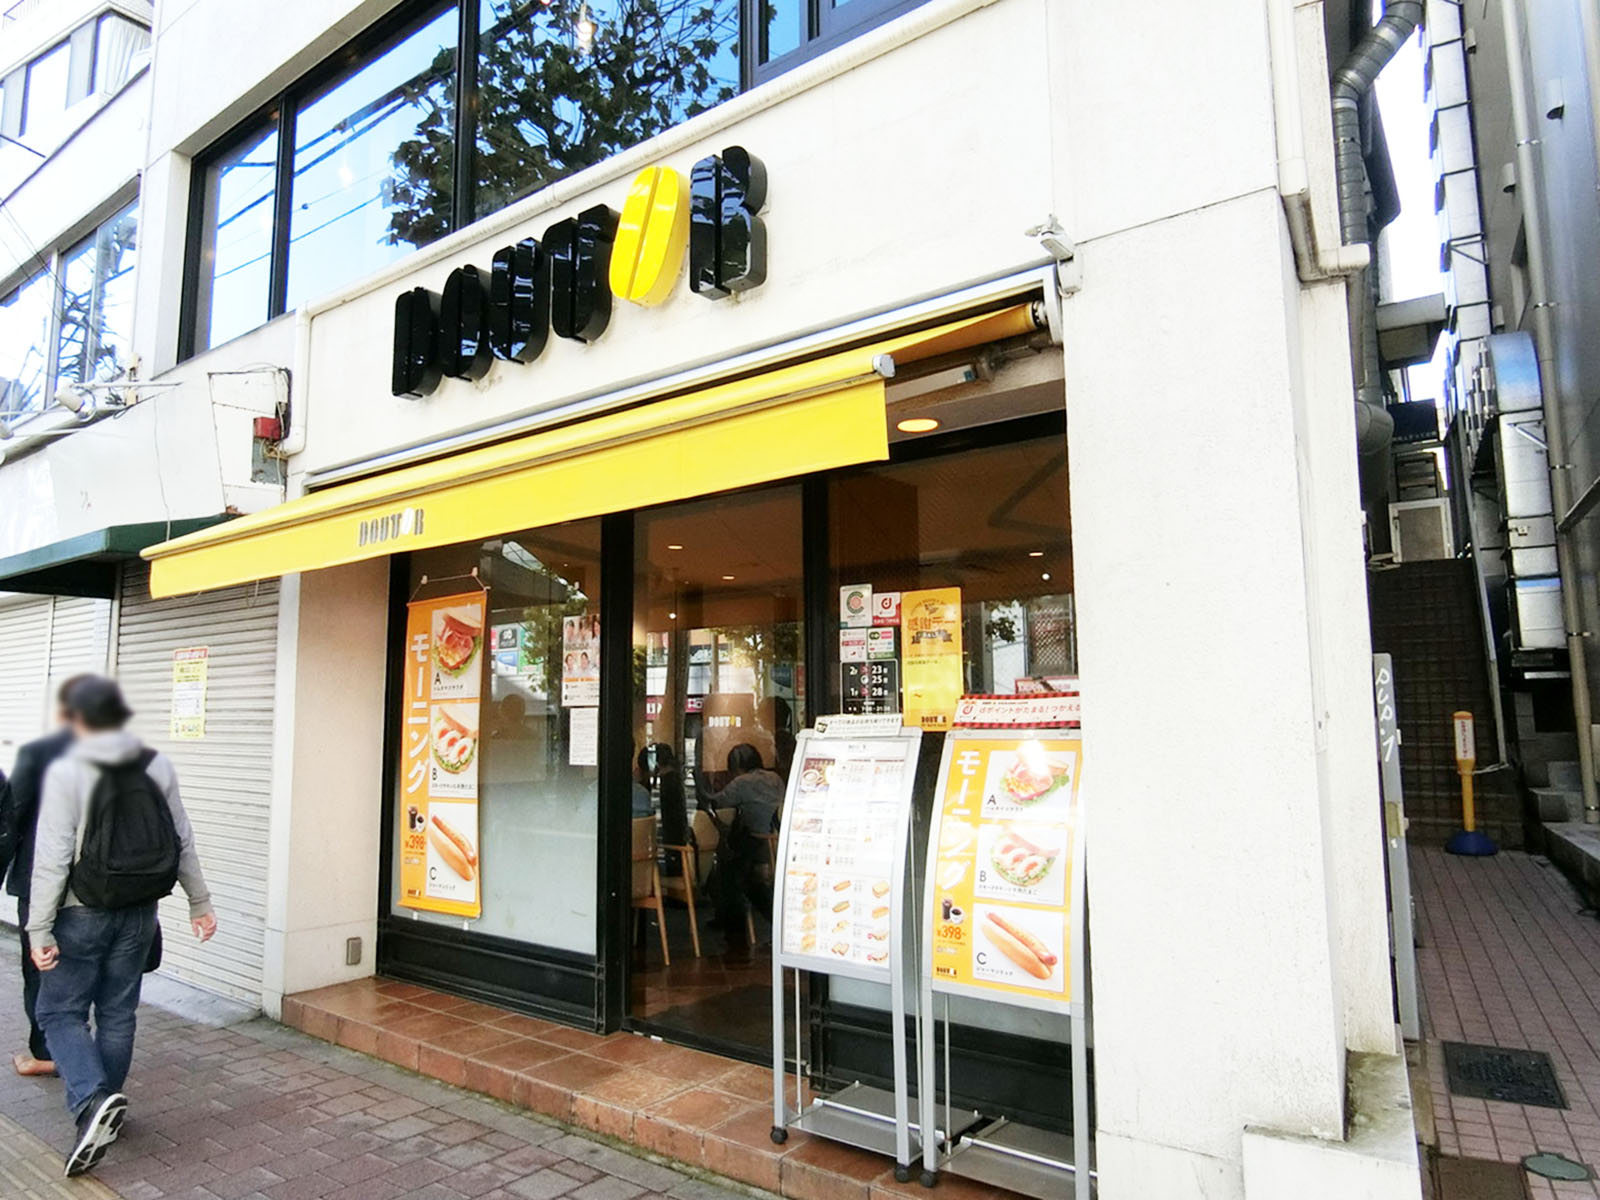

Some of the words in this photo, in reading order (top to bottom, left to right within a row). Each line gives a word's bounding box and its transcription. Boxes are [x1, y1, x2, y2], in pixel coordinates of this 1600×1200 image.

[392, 146, 767, 399] DOUTOR
[359, 507, 424, 547] DOUTOR
[434, 672, 442, 685] A
[406, 633, 430, 794] モーニング
[708, 715, 742, 728] DOUTOR
[432, 768, 438, 781] B
[987, 794, 997, 805] A
[429, 866, 437, 880] C
[979, 870, 987, 882] B
[976, 952, 987, 965] C
